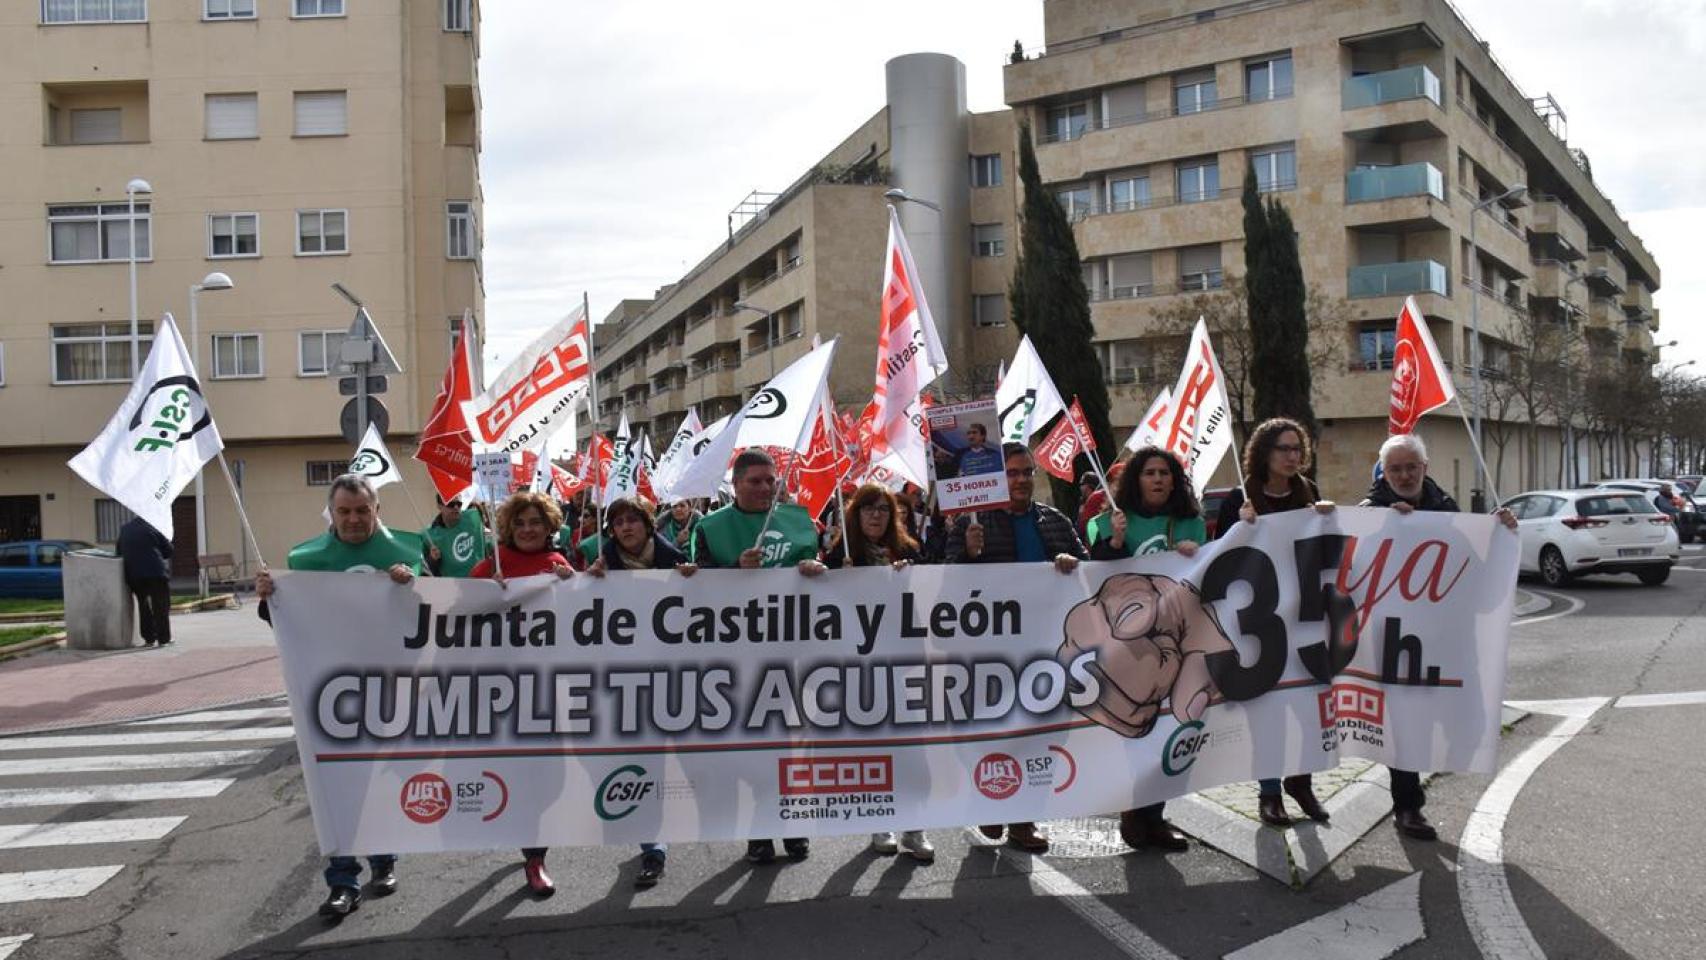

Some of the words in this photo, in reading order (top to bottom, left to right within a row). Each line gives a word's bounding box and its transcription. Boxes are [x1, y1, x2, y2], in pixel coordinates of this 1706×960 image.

[946, 481, 961, 493] 35
[964, 479, 998, 490] HORAS
[762, 541, 792, 561] SIF
[1336, 536, 1469, 642] ya
[404, 603, 556, 649] Junta
[572, 598, 637, 646] de
[652, 594, 842, 645] Castilla
[857, 603, 886, 655] y
[900, 588, 1022, 639] León
[1202, 534, 1358, 700] 35
[1381, 616, 1441, 686] h.
[317, 671, 593, 740] CUMPLE
[609, 668, 732, 732] TUS
[747, 650, 1101, 729] ACUERDOS
[1352, 730, 1384, 748] León
[786, 761, 887, 788] CCOO
[980, 760, 1017, 781] UGT
[407, 781, 446, 801] UGT
[606, 781, 654, 802] CSIF
[779, 795, 820, 807] área
[826, 792, 894, 807] pública
[779, 806, 839, 820] Castilla
[843, 809, 853, 820] y
[857, 804, 896, 817] León
